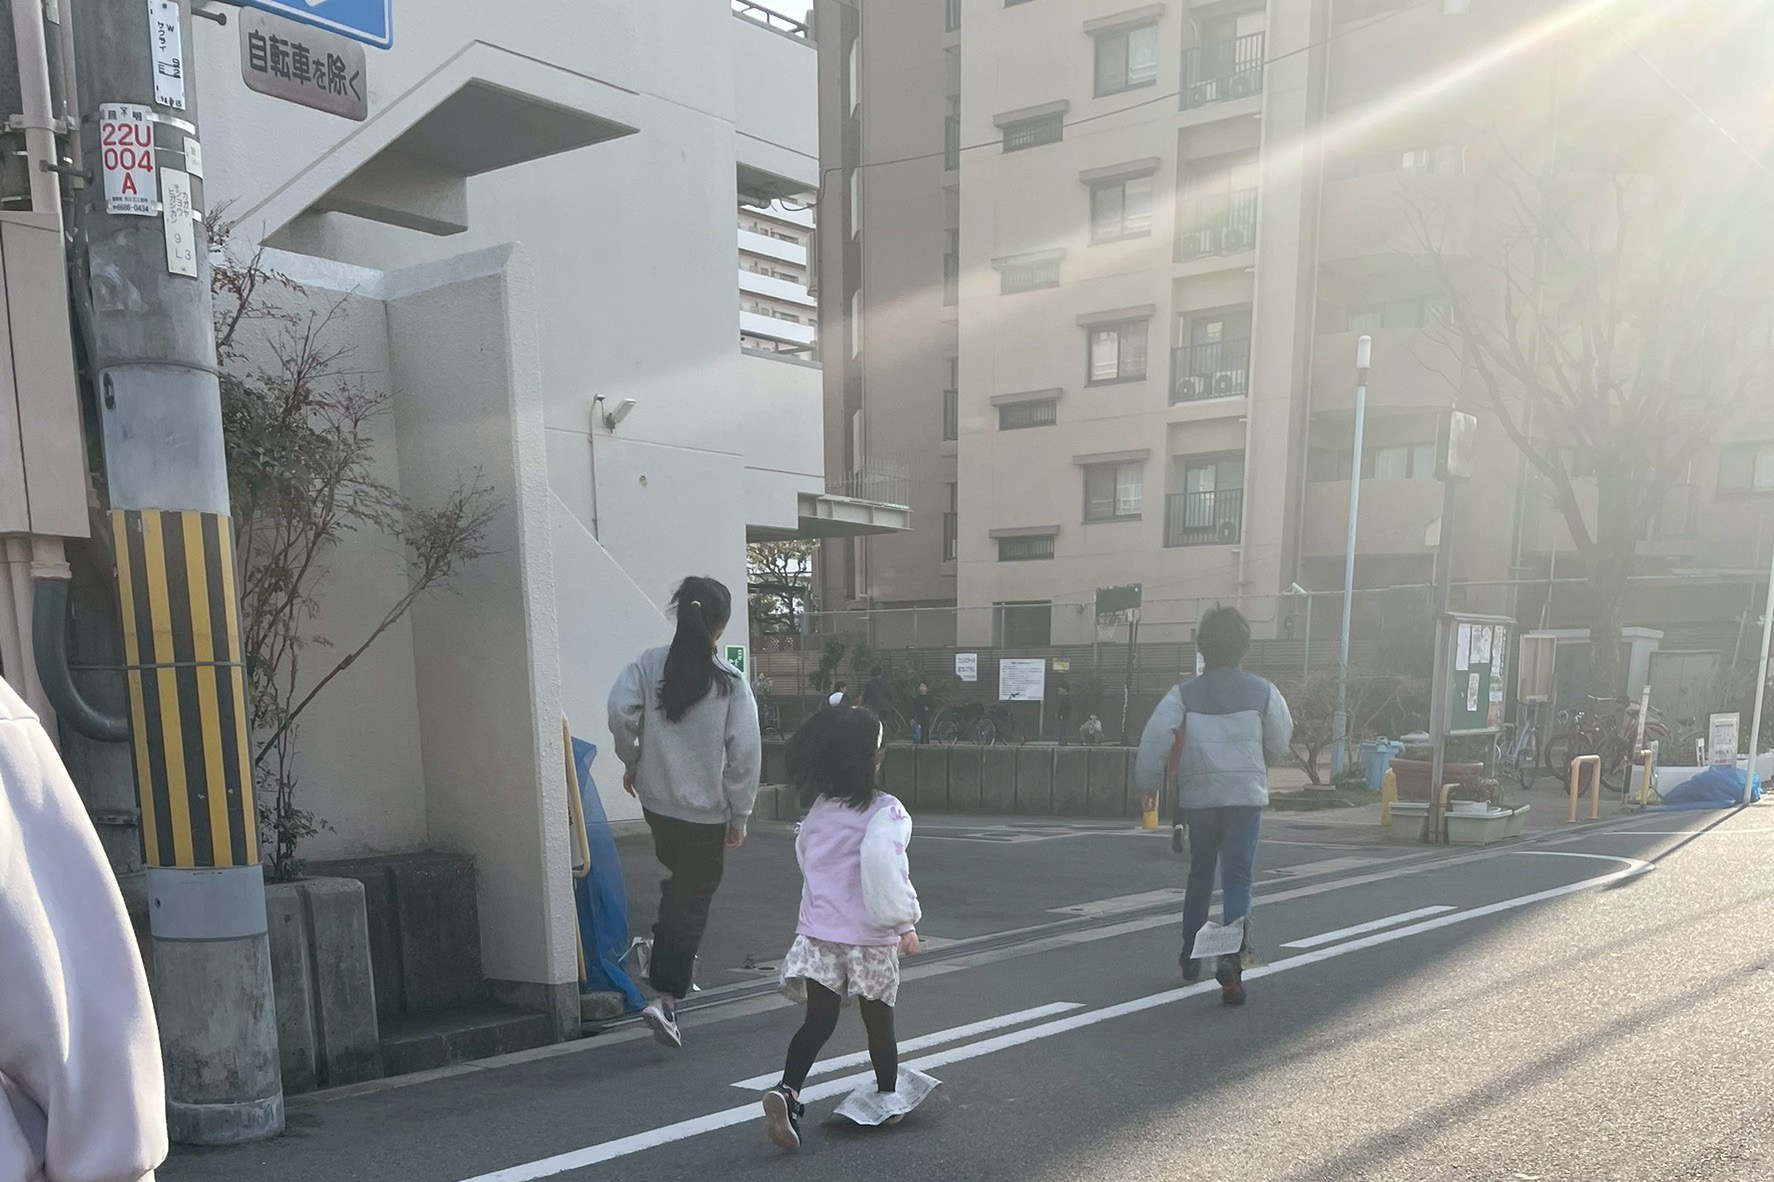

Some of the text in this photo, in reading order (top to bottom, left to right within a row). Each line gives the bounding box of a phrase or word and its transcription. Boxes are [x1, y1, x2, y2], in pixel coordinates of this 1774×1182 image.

[248, 29, 361, 102] 自転車を除く
[102, 122, 151, 147] 22U
[104, 147, 153, 172] 004
[122, 172, 137, 194] A
